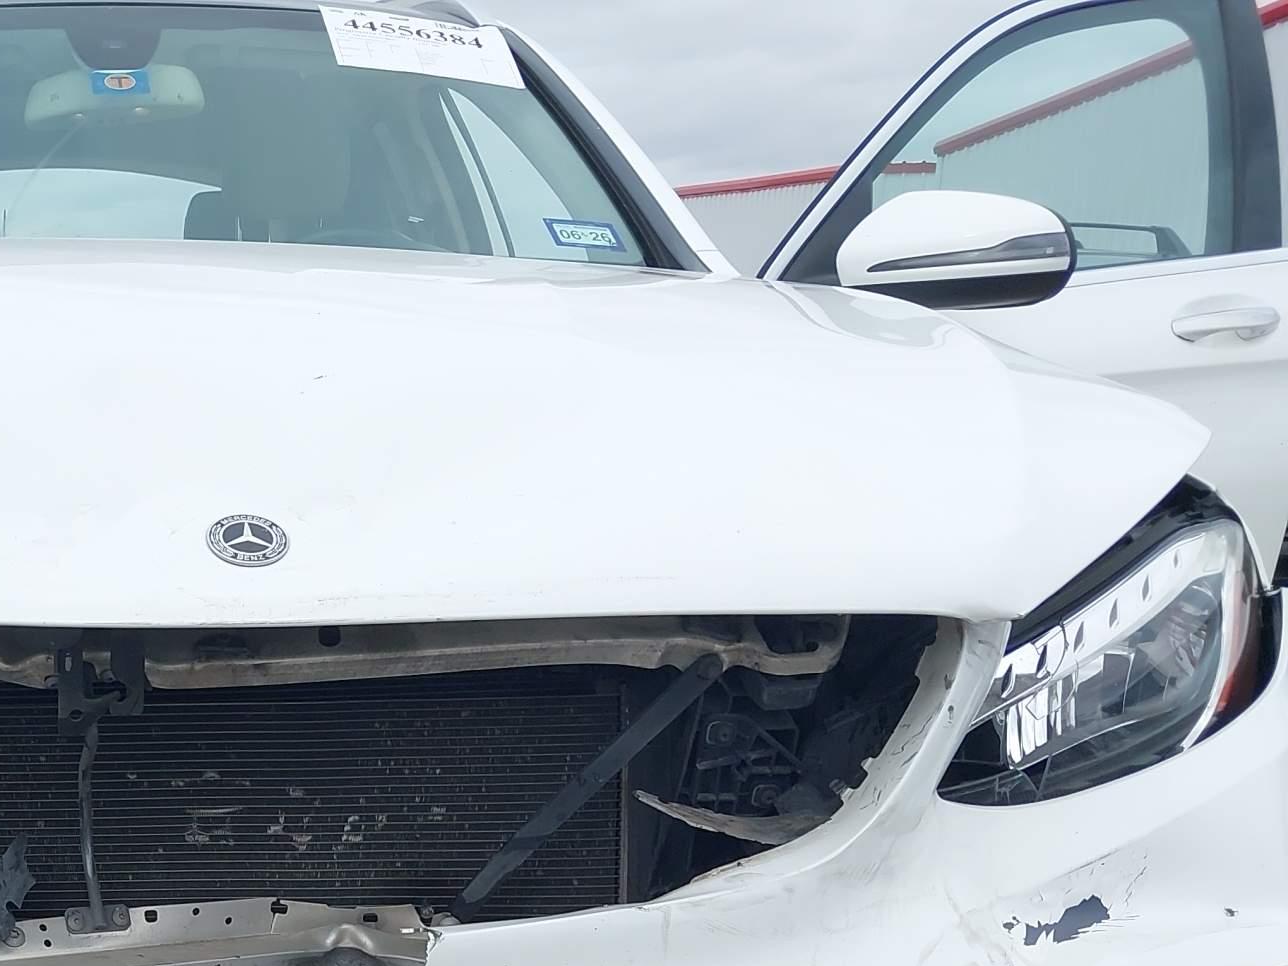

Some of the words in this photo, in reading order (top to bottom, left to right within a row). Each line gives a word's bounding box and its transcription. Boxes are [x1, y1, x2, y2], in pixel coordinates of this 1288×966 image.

[344, 18, 483, 49] 44556384
[220, 514, 273, 527] MERCEDES
[236, 552, 266, 561] BENZ
